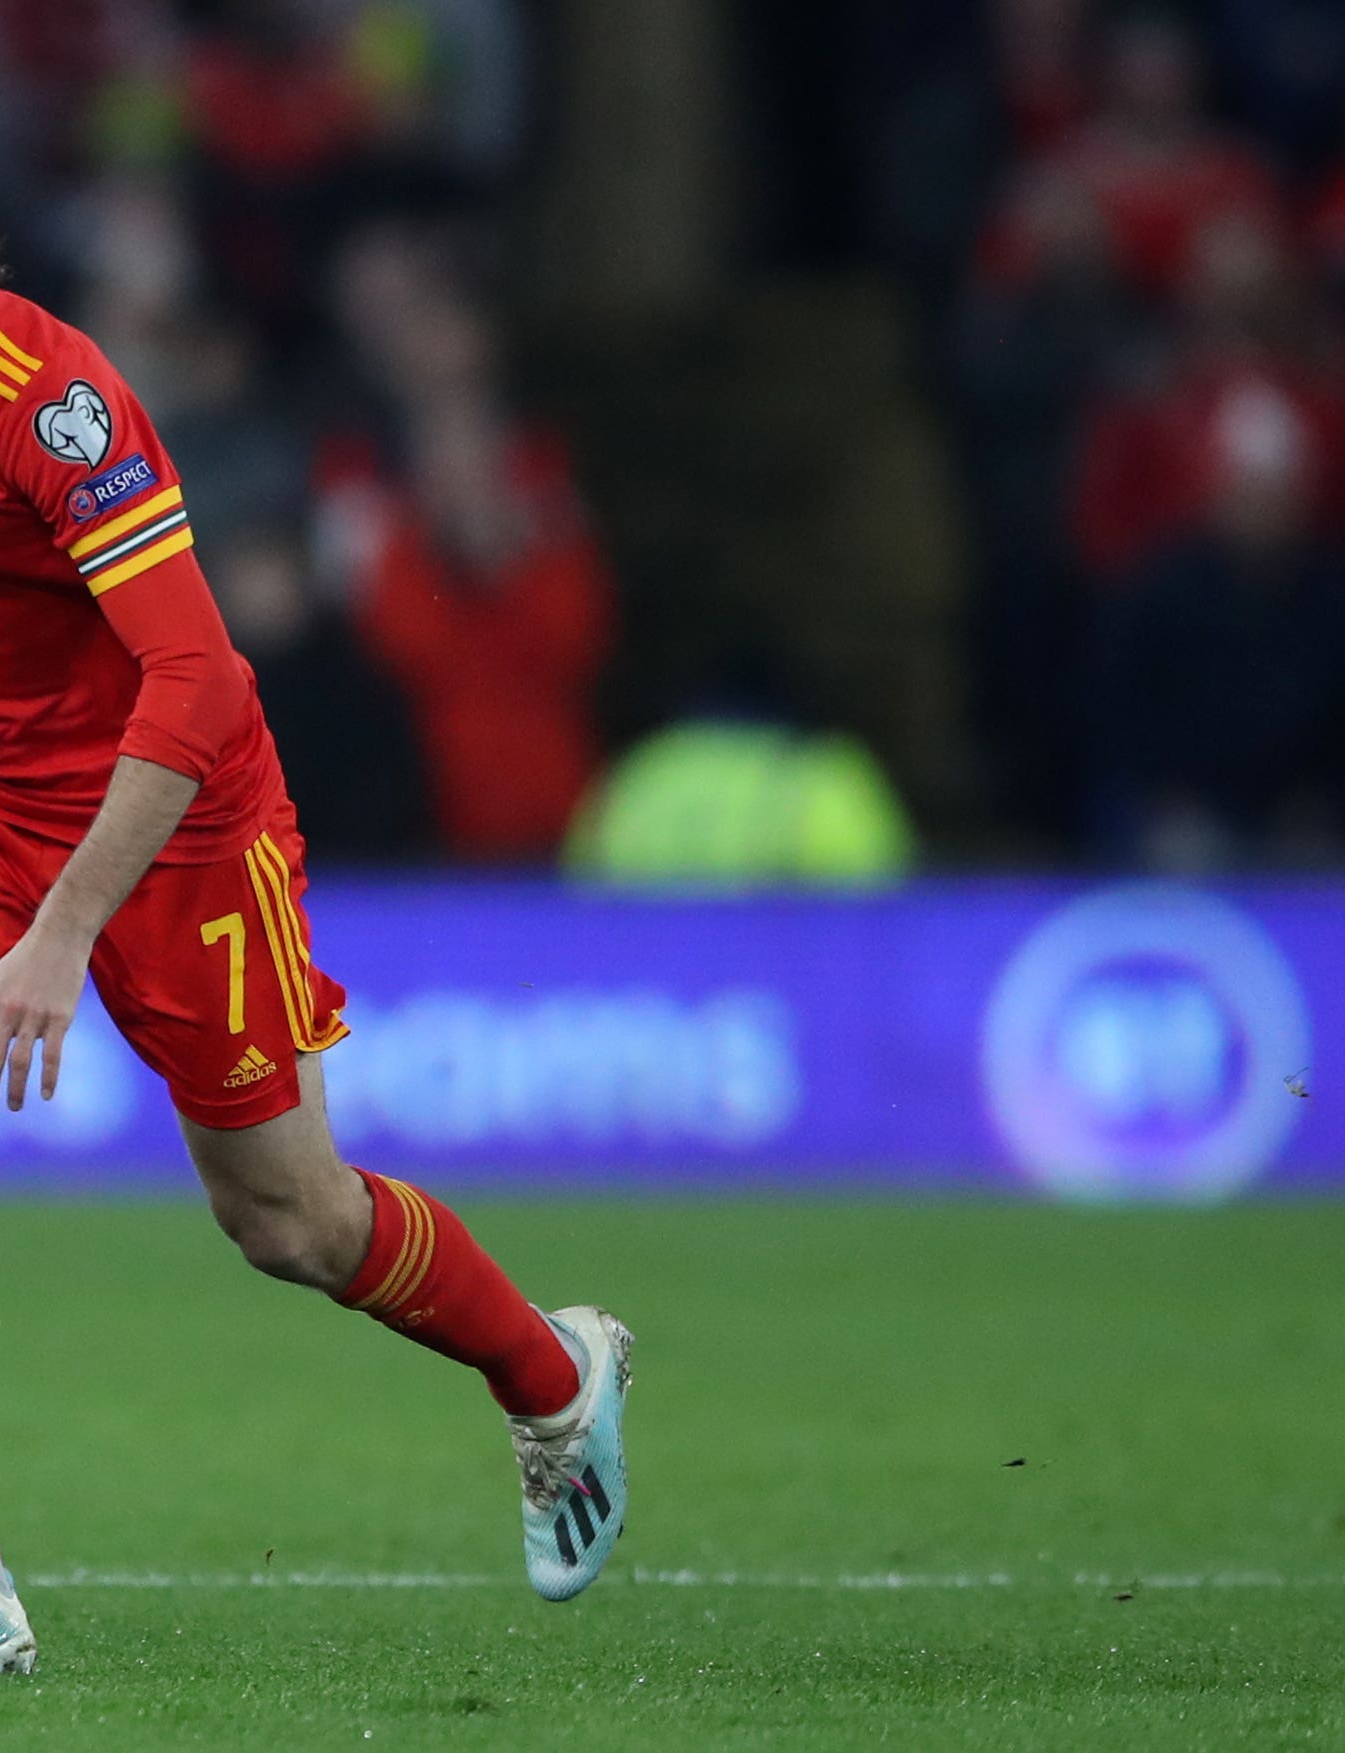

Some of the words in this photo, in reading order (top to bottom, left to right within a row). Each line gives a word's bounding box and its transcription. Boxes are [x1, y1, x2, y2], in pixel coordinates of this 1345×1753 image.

[95, 461, 151, 502] RESPECT
[200, 911, 246, 1035] 7
[223, 1061, 277, 1089] adidas
